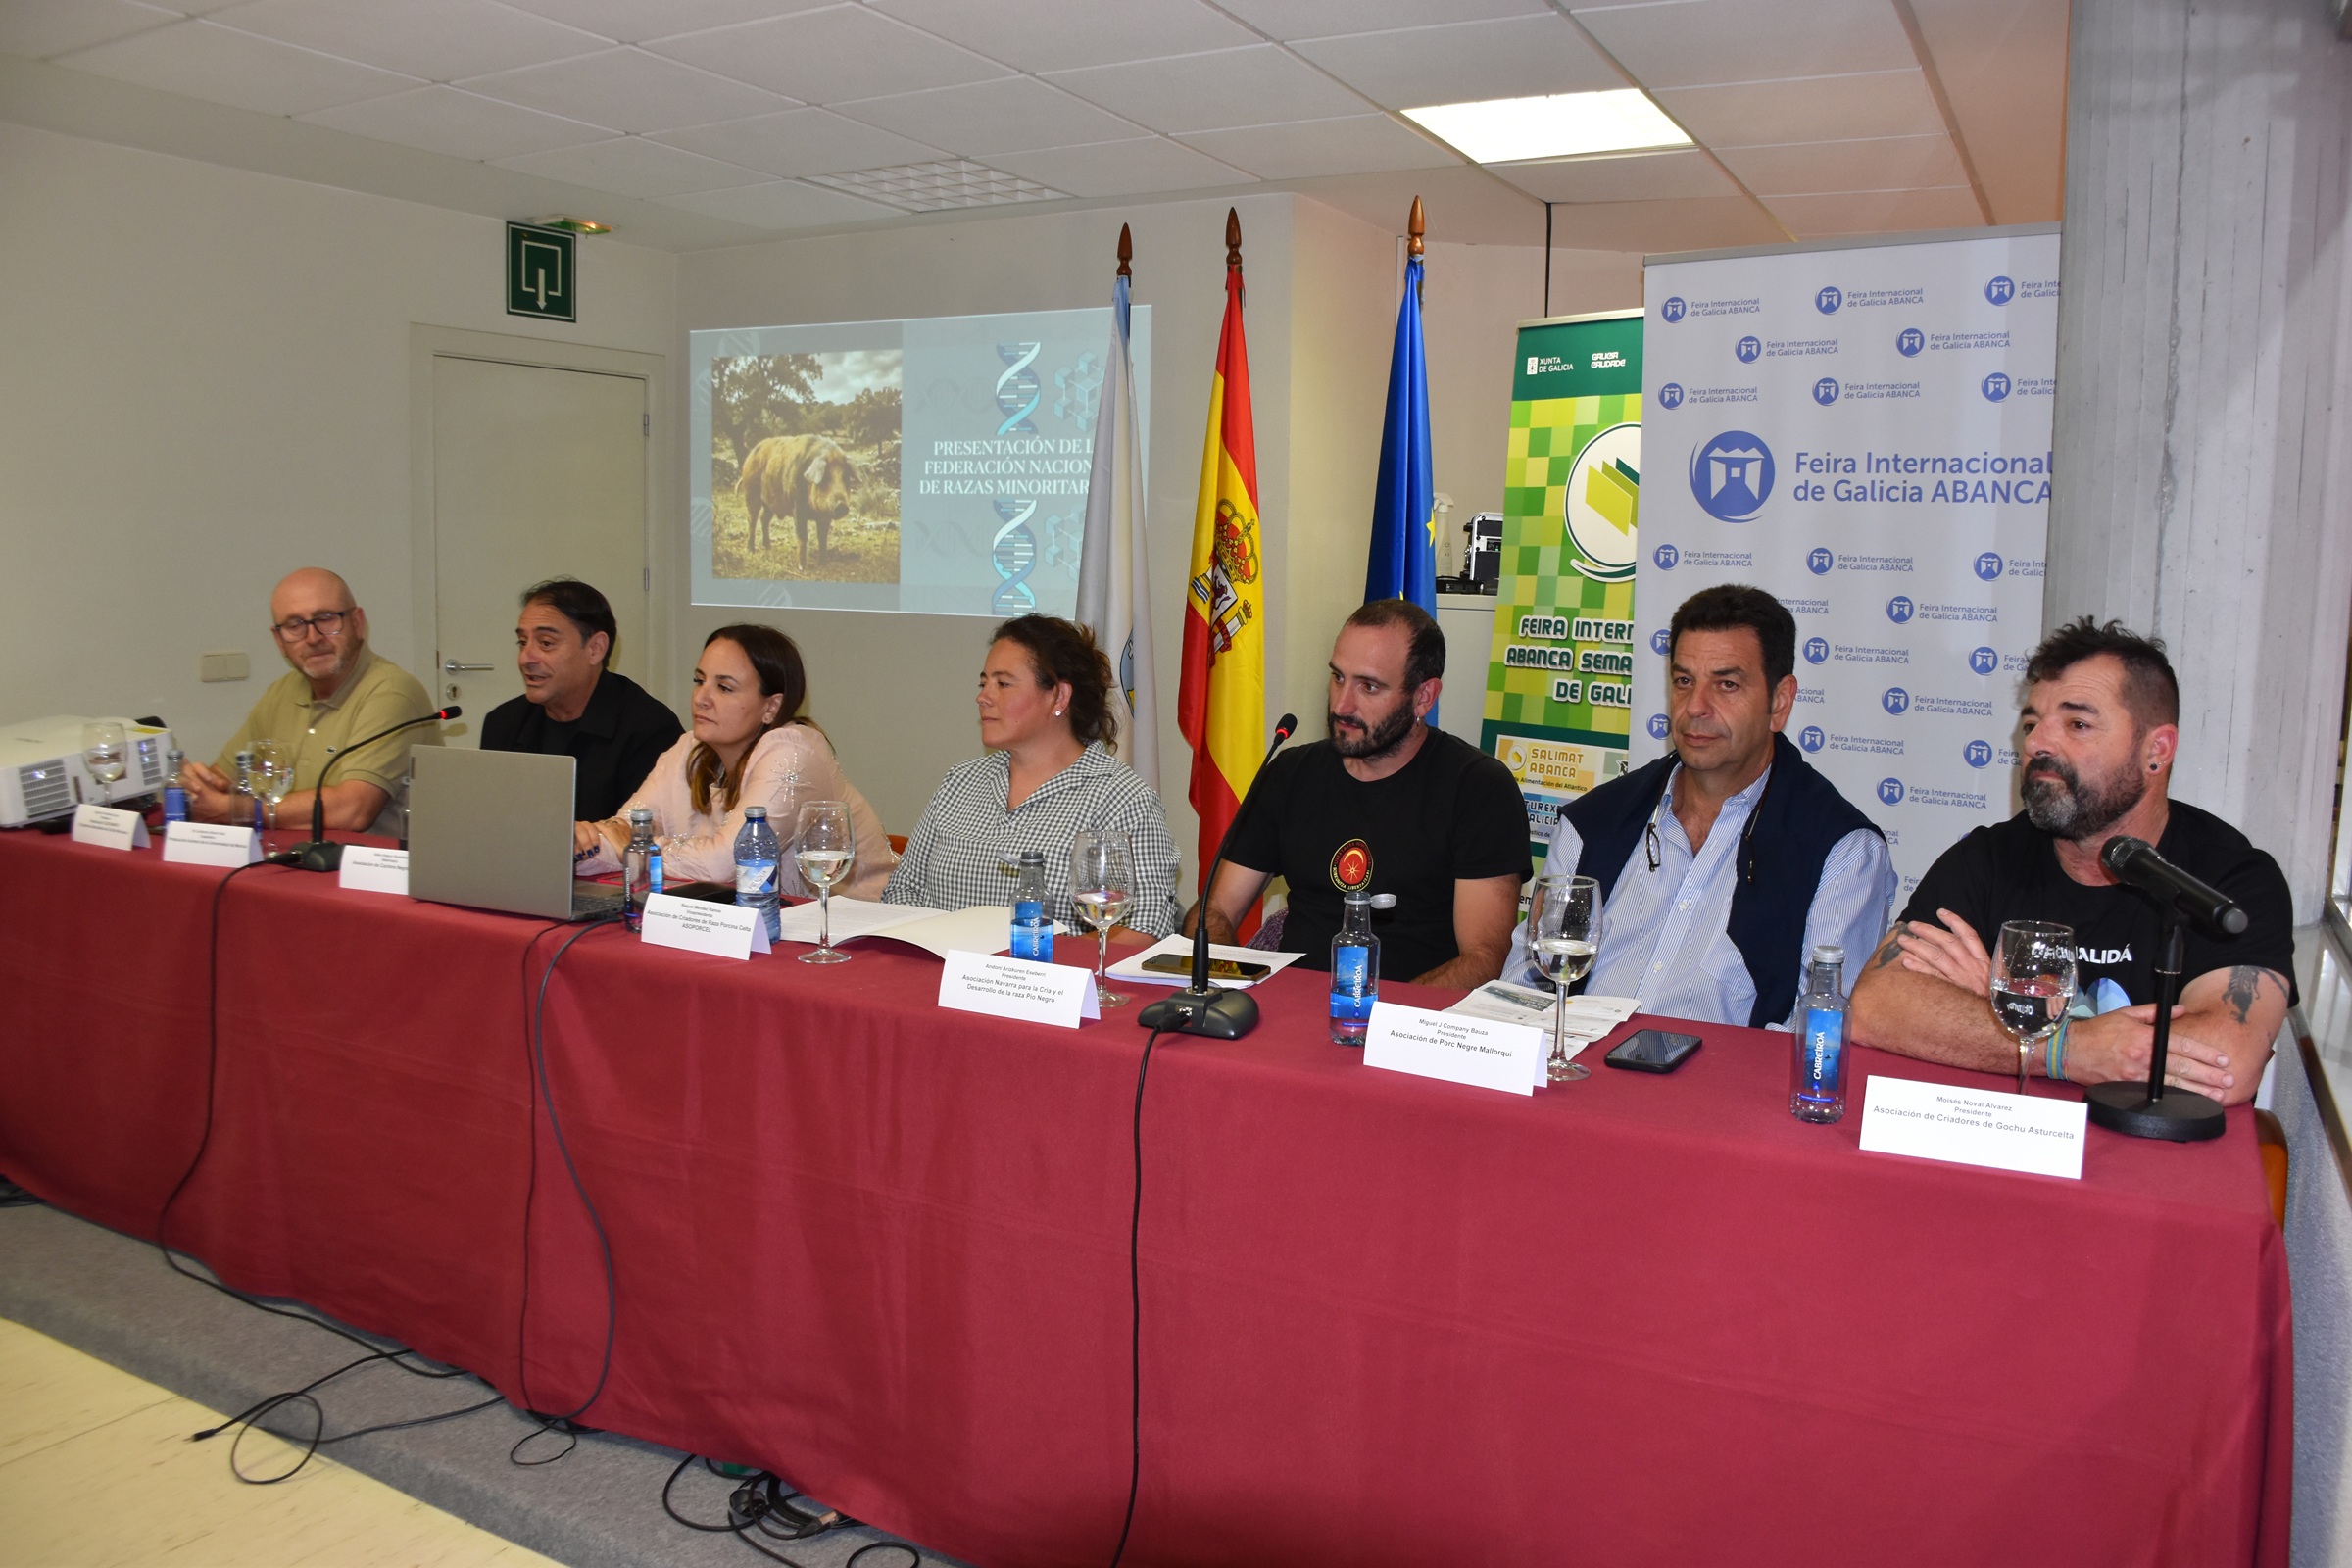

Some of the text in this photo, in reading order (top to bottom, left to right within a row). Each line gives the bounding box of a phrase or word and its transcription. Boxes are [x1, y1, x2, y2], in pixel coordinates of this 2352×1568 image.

[1869, 287, 1923, 298] Internacional
[2021, 290, 2033, 299] de
[1691, 298, 1760, 310] Feira Internacional
[1888, 296, 1924, 305] ABANCA
[1701, 308, 1727, 317] Galicia
[1728, 306, 1761, 315] ABANCA
[1931, 331, 2010, 342] Feira Internacional
[1787, 338, 1838, 348] Internacional
[1942, 341, 1972, 350] Galicia
[1973, 340, 2011, 349] ABANCA
[1805, 346, 1839, 355] ABANCA
[1548, 364, 1574, 372] GALICIA
[1689, 386, 1758, 397] Feira Internacional
[1725, 394, 1758, 403] ABANCA
[934, 436, 1094, 456] PRESENTACIÓN DE L
[924, 457, 1092, 475] FEDERACIÓN NACION
[1795, 450, 2054, 476] Feira Internacional
[919, 479, 1089, 495] DE RAZAS MINORITAR
[1793, 479, 2050, 506] de Galicia ABANCA
[1684, 551, 1752, 561] Feira Internacional
[2009, 560, 2031, 569] Feira
[1920, 604, 1998, 614] Feira Internacional
[1931, 612, 1960, 621] Galicia
[1961, 613, 1998, 623] ABANCA
[1521, 618, 1565, 636] FEIRA
[1835, 646, 1909, 657] Feira Internacional
[1506, 647, 1632, 671] ABANCA SEMA
[1845, 654, 1873, 662] Galicia
[1875, 655, 1909, 664] ABANCA
[1556, 682, 1631, 704] DE GALI
[1915, 696, 1992, 709] Feira Internacional
[1927, 705, 1955, 714] Galicia
[1956, 707, 1993, 716] ABANCA
[1830, 734, 1904, 748] Feira Internacional
[1840, 743, 1869, 753] Galicia
[1870, 746, 1905, 756] ABANCA
[1999, 749, 2019, 758] Feira
[1531, 748, 1584, 764] SALIMAT
[1530, 762, 1576, 778] ABANCA
[1520, 777, 1554, 788] Alimentación
[1910, 787, 1986, 802] Feira Internacional
[1921, 796, 1949, 806] Galicia
[1950, 799, 1987, 809] ABANCA
[961, 974, 994, 985] Asociación
[995, 979, 1017, 989] Navarra
[967, 983, 997, 994] Desarrollo
[1037, 995, 1055, 1004] Negro
[1419, 1018, 1438, 1027] Miguel
[1443, 1023, 1470, 1034] Company
[1437, 1030, 1467, 1040] Presidente
[1390, 1030, 1428, 1043] Asociación
[1439, 1038, 1455, 1048] Porc
[1456, 1042, 1478, 1052] Negre
[1936, 1096, 1962, 1105] Moisés
[1954, 1106, 1992, 1118] Presidente
[1873, 1105, 2075, 1140] Asociación de Criadores de Gochu Asturcelta
